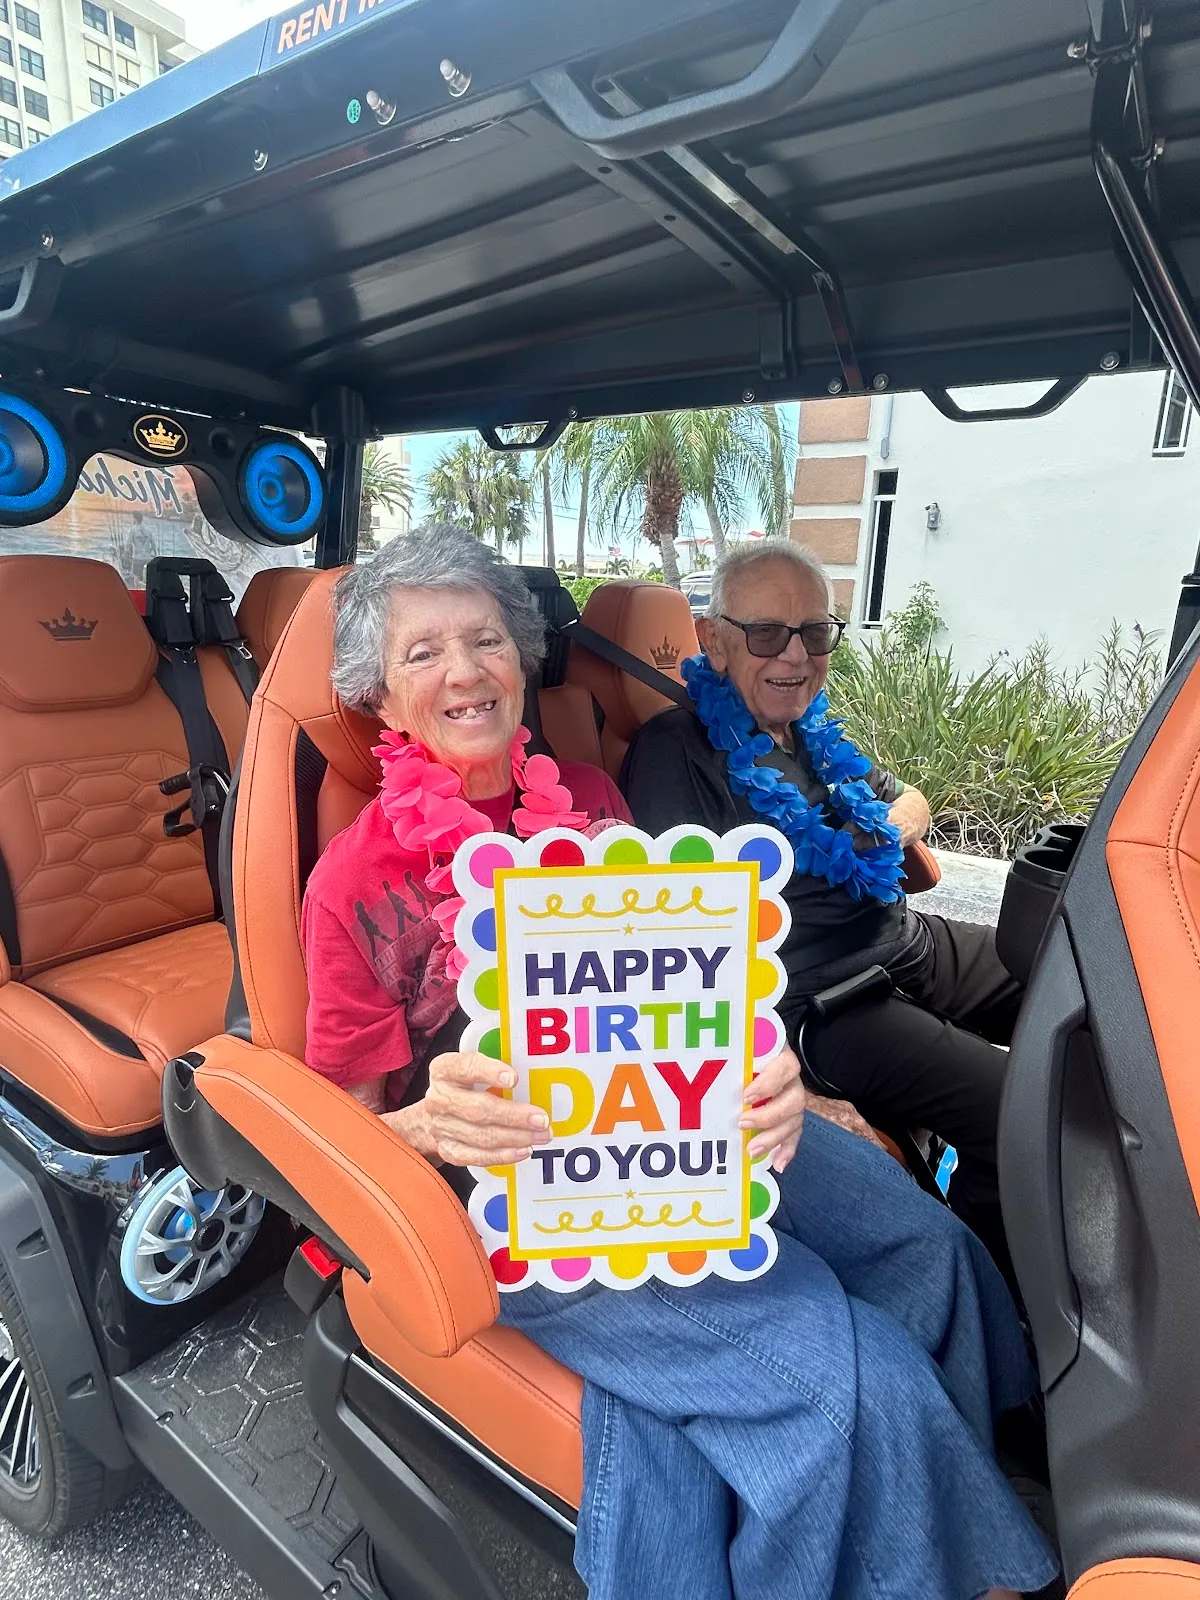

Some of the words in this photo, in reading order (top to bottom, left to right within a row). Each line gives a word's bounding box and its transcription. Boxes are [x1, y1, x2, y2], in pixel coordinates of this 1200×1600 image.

[277, 0, 350, 54] RENT
[524, 946, 732, 997] HAPPY
[526, 1000, 731, 1056] BIRTH
[528, 1059, 729, 1138] DAY
[531, 1146, 601, 1185] TO
[604, 1139, 728, 1180] YOU!
